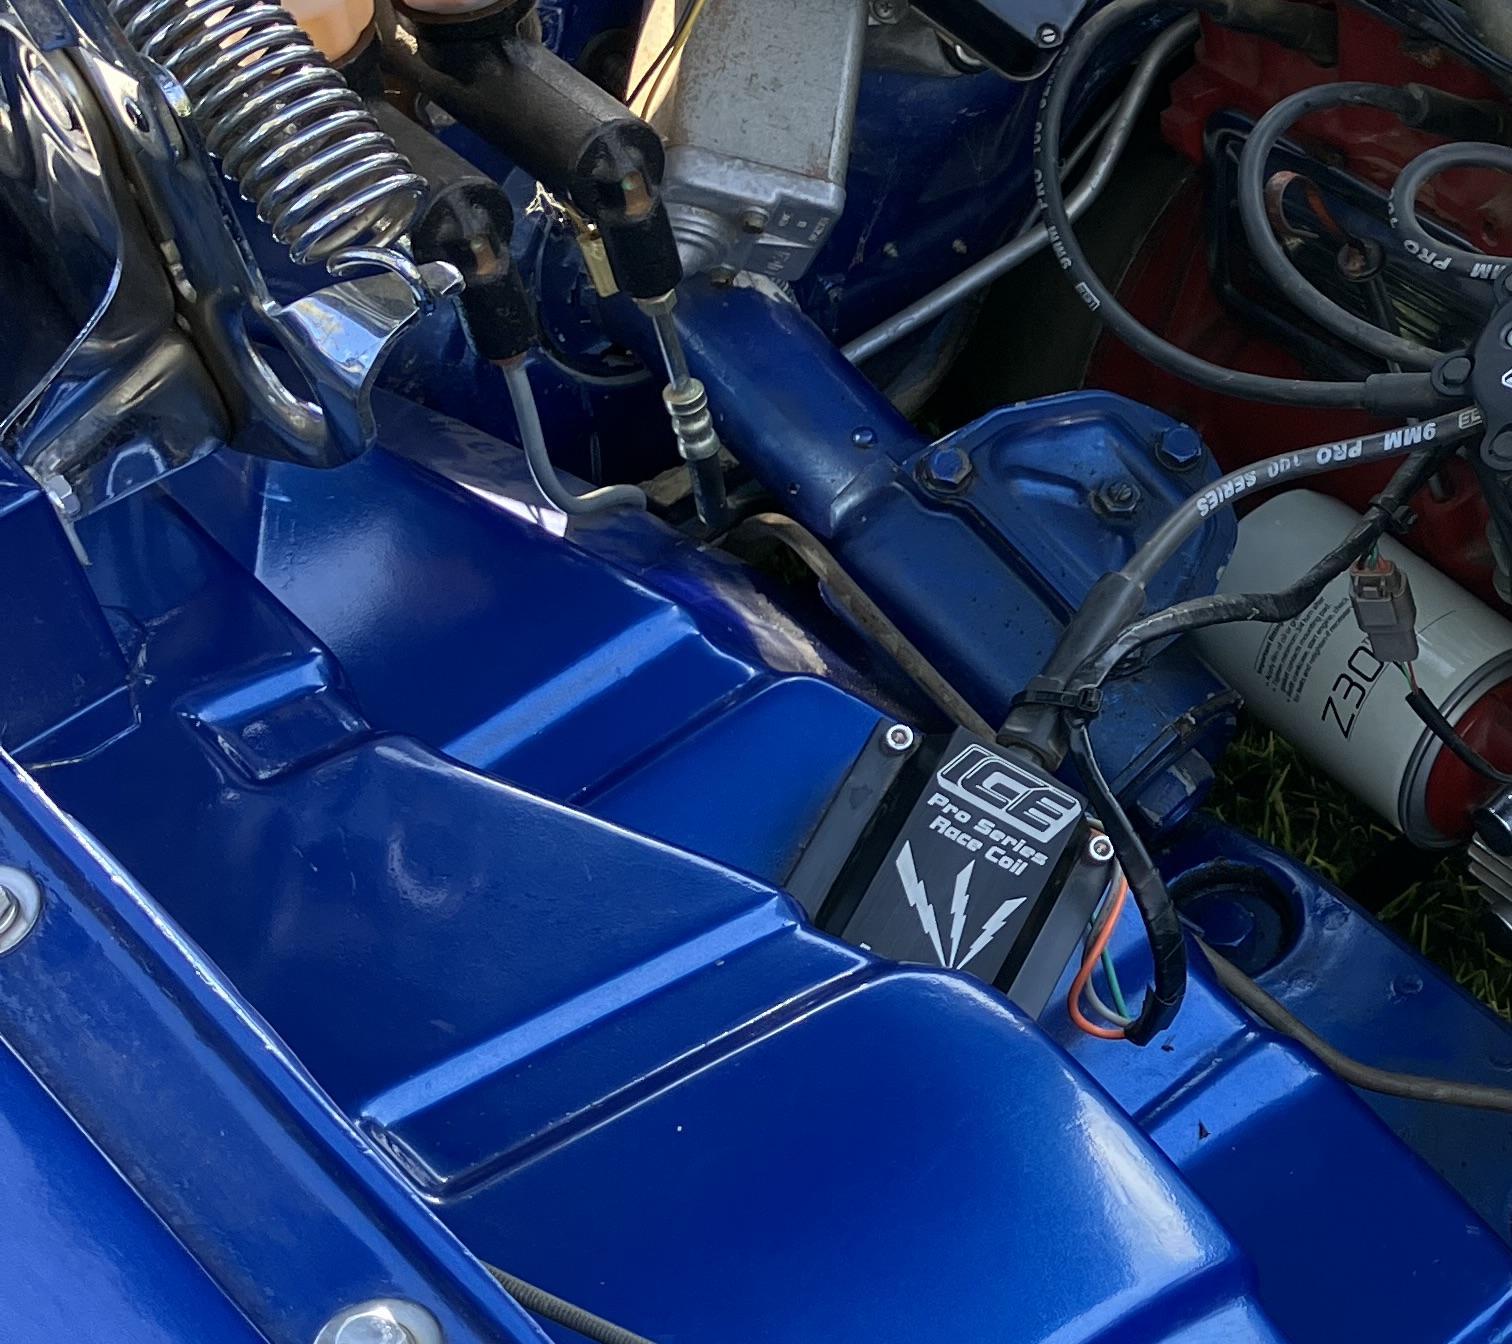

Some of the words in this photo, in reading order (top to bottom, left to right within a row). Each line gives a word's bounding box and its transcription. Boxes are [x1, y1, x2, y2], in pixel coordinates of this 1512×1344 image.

[1403, 240, 1452, 270] PRO
[1317, 440, 1363, 465] PRO
[1383, 422, 1437, 451] 9MM
[1197, 470, 1257, 517] SERIES
[1321, 646, 1385, 739] Z30
[937, 743, 1082, 843] ICE
[927, 792, 970, 824] Pro
[973, 812, 1049, 867] Series
[929, 815, 983, 853] Race
[985, 844, 1029, 877] Coil
